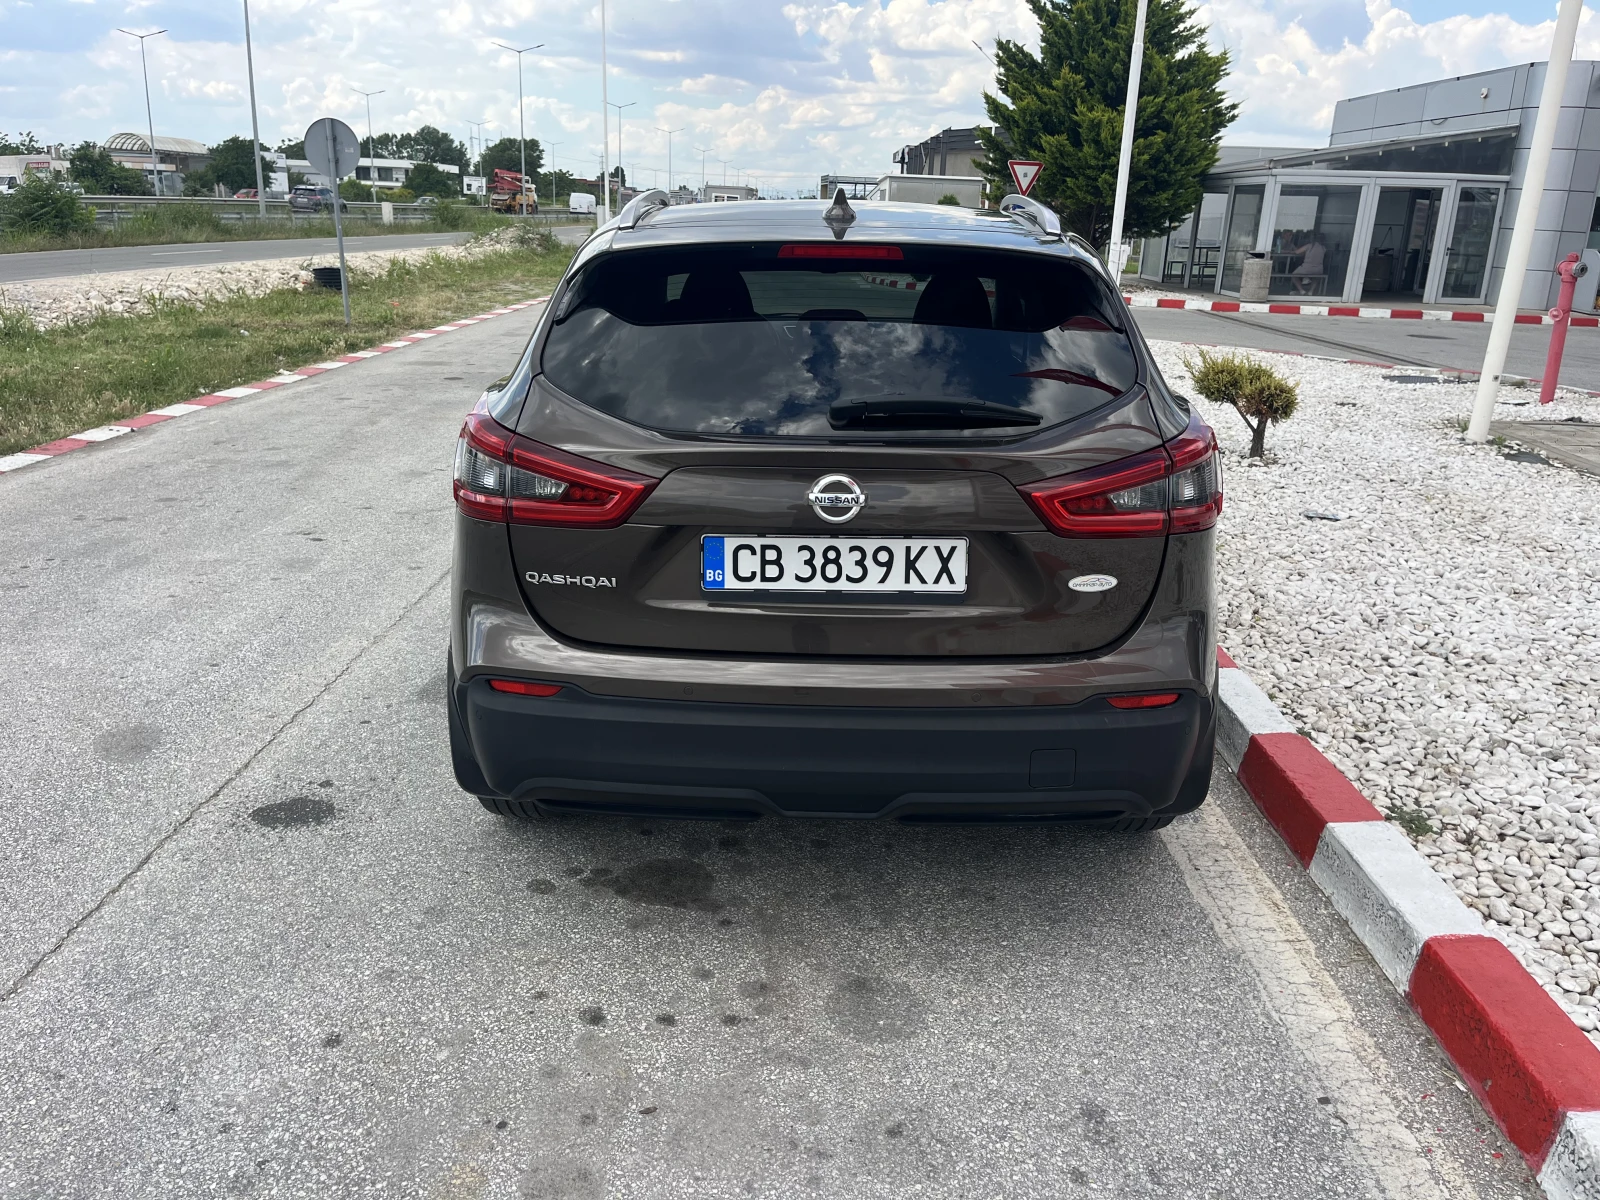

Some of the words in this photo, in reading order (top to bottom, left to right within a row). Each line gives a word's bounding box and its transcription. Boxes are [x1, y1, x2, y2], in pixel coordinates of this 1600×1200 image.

[814, 495, 860, 504] NISSAN
[732, 543, 784, 582] CB
[794, 544, 895, 584] 3839
[904, 545, 958, 585] KX
[525, 571, 617, 589] QASHQAI
[706, 569, 723, 582] BG
